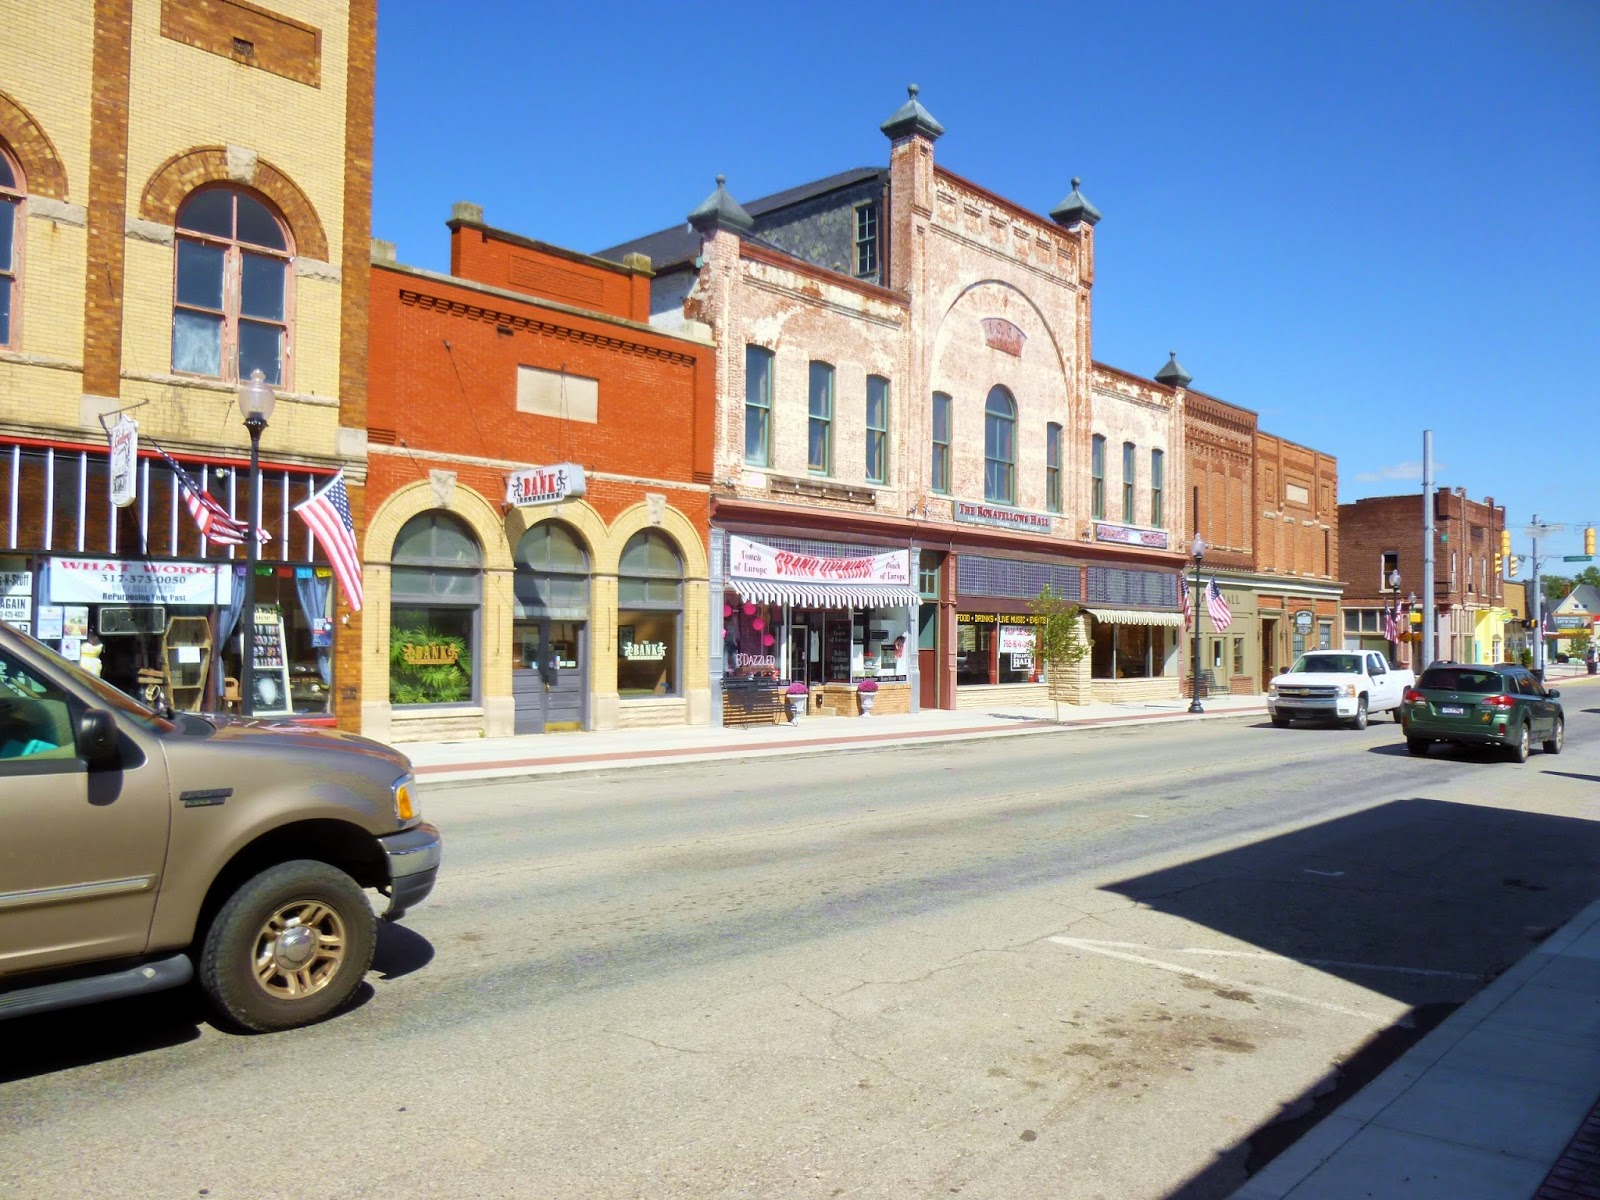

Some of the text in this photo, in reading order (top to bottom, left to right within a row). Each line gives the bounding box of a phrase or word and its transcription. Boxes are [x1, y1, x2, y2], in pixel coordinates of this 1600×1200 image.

[524, 474, 556, 496] BANK
[958, 502, 976, 515] THE
[1030, 515, 1049, 527] HALL
[61, 561, 131, 572] WHAT
[734, 563, 768, 575] of Europe
[775, 550, 820, 577] GRAND
[101, 574, 186, 585] 317-373-0050
[102, 593, 150, 602] RePurposing
[0, 598, 26, 610] AGAIN
[956, 614, 971, 622] FOOD
[975, 614, 994, 623] DRINKS
[999, 615, 1010, 624] LIVE
[1010, 616, 1026, 624] MUSIC
[416, 645, 448, 659] BANK
[634, 644, 658, 656] BANK
[736, 653, 776, 667] B'DAZZLED
[1013, 659, 1032, 668] HALL
